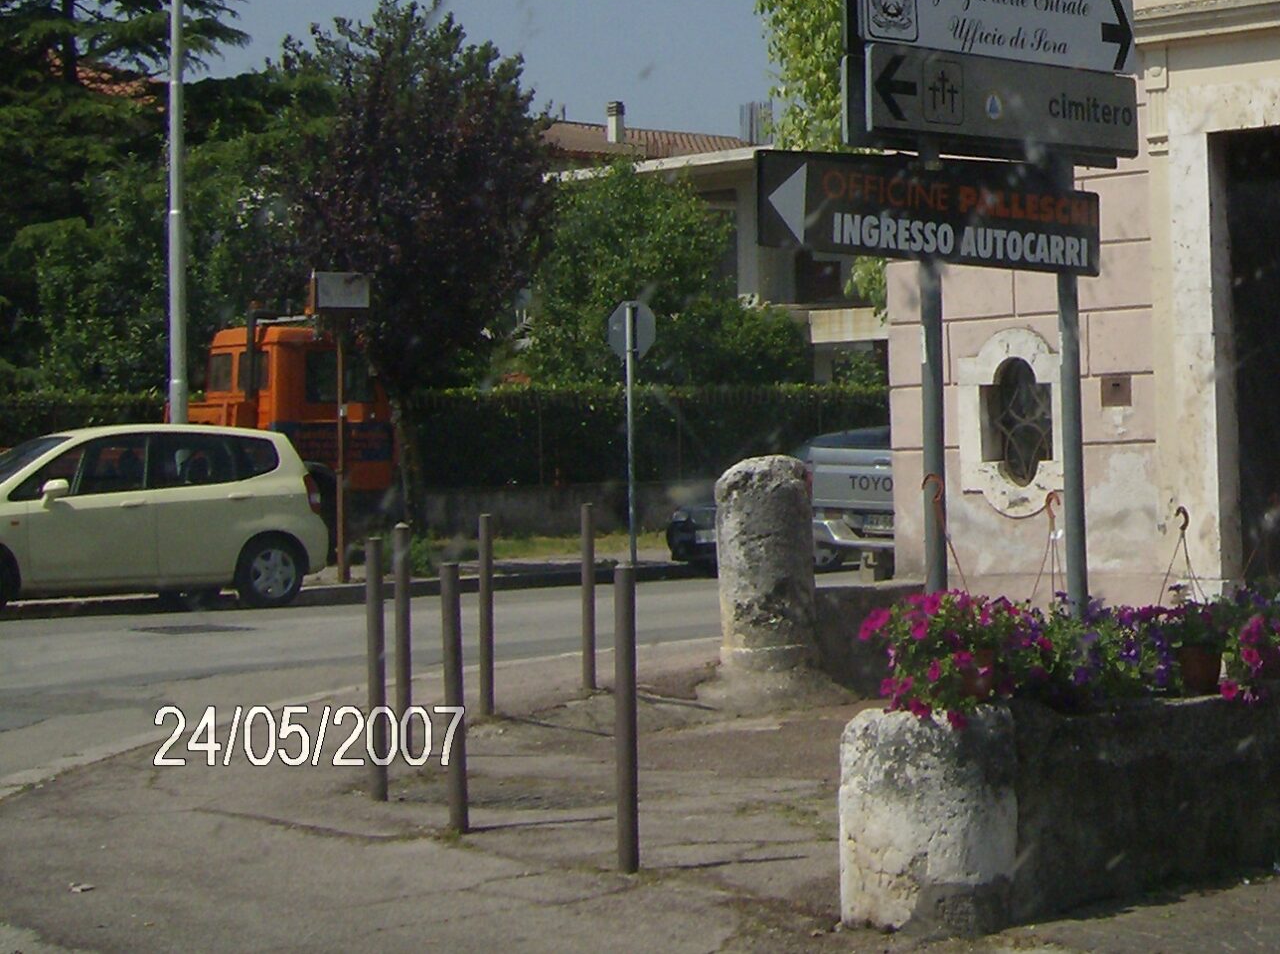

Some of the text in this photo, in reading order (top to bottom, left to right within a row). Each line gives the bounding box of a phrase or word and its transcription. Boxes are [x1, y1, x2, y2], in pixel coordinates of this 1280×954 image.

[949, 15, 1069, 55] Ufficio di Sora
[1048, 93, 1133, 127] cimitero
[821, 170, 949, 213] OFFICINE
[833, 212, 1088, 267] INGRESSO AUTOCARRI
